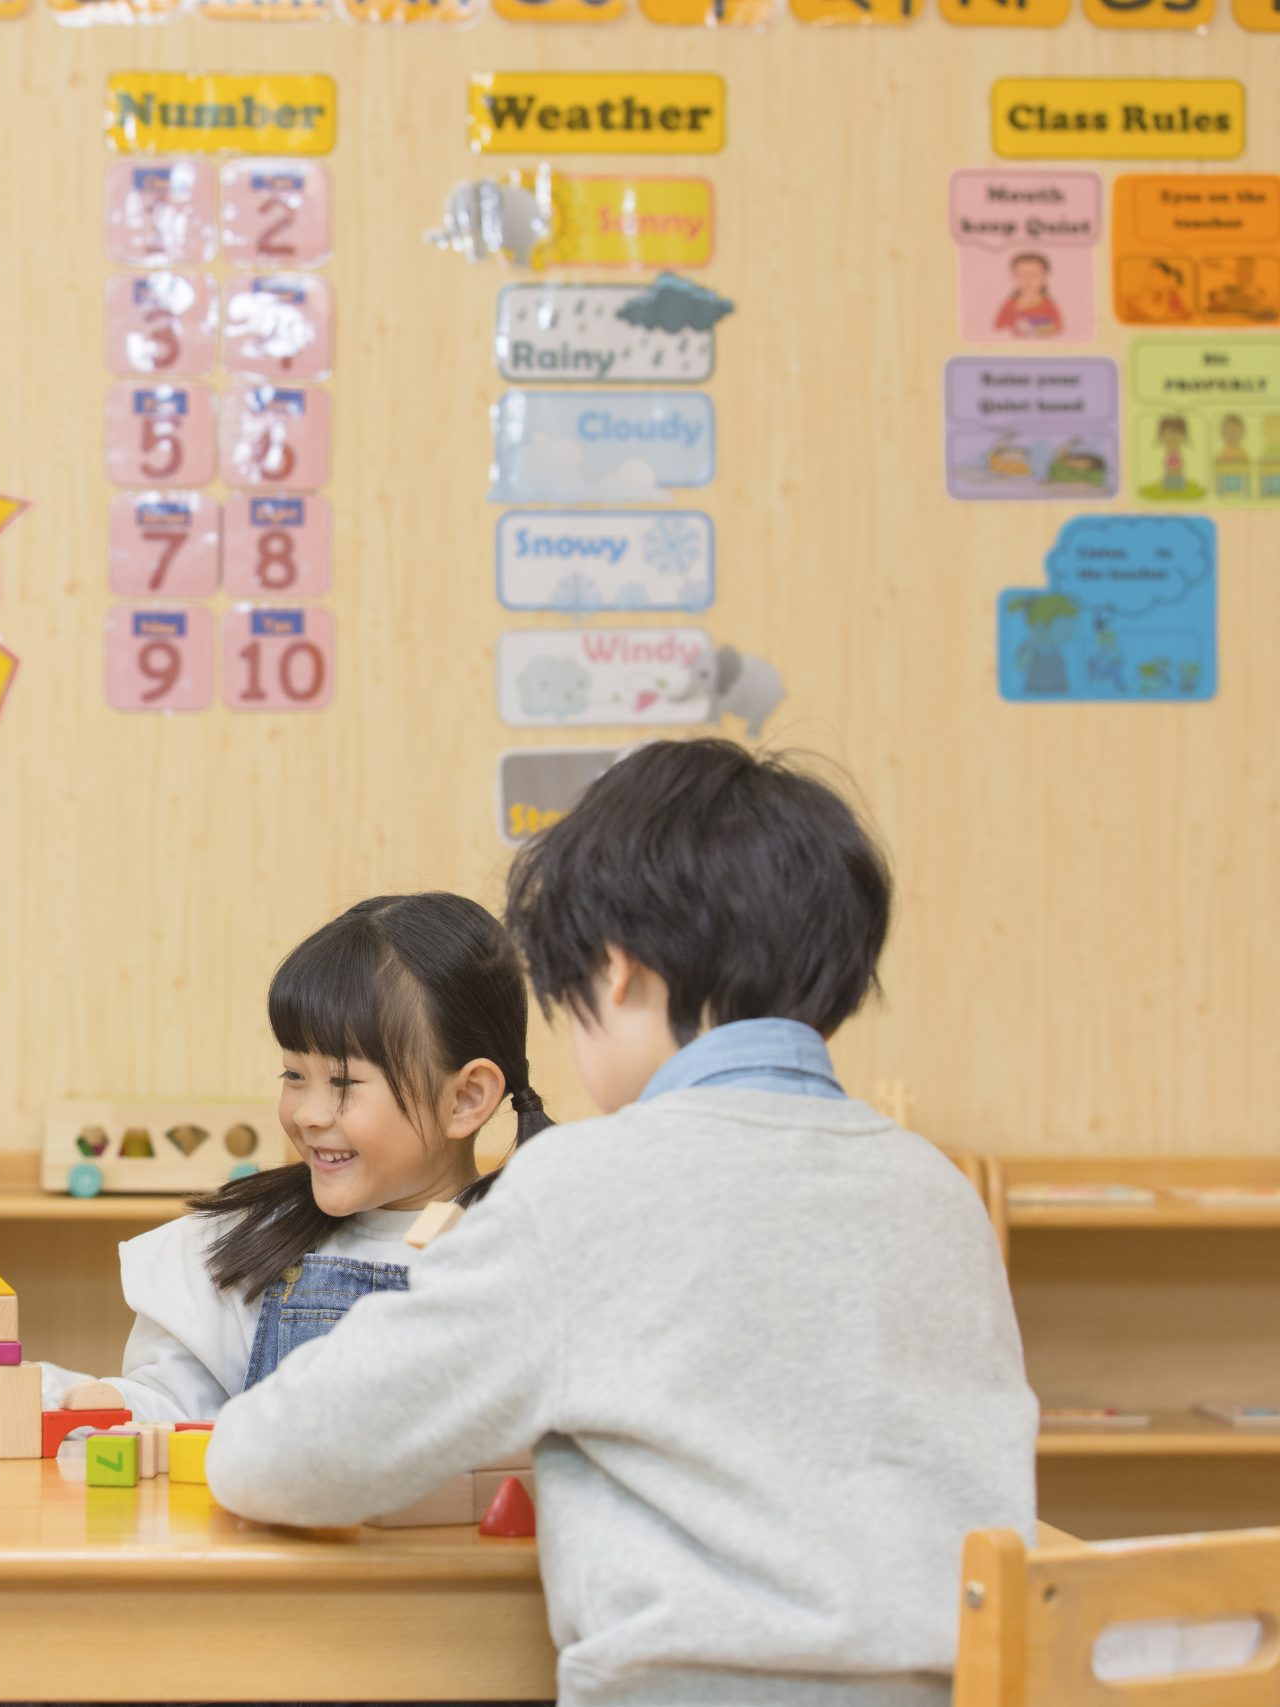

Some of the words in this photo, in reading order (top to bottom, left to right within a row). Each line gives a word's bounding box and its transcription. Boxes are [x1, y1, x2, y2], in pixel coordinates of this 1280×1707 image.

[115, 91, 324, 130] Number
[482, 94, 713, 133] Weather
[1007, 104, 1108, 133] Class
[1122, 104, 1231, 133] Rules
[256, 196, 297, 256] 2
[599, 205, 705, 241] Sunny
[510, 340, 616, 380] Rainy
[578, 410, 704, 447] Cloudy
[139, 418, 183, 479] 5
[141, 531, 189, 592] 7
[255, 530, 299, 590] 8
[514, 527, 630, 565] Snowy
[581, 633, 701, 669] Windy
[137, 640, 183, 704] 9
[238, 640, 326, 703] 10
